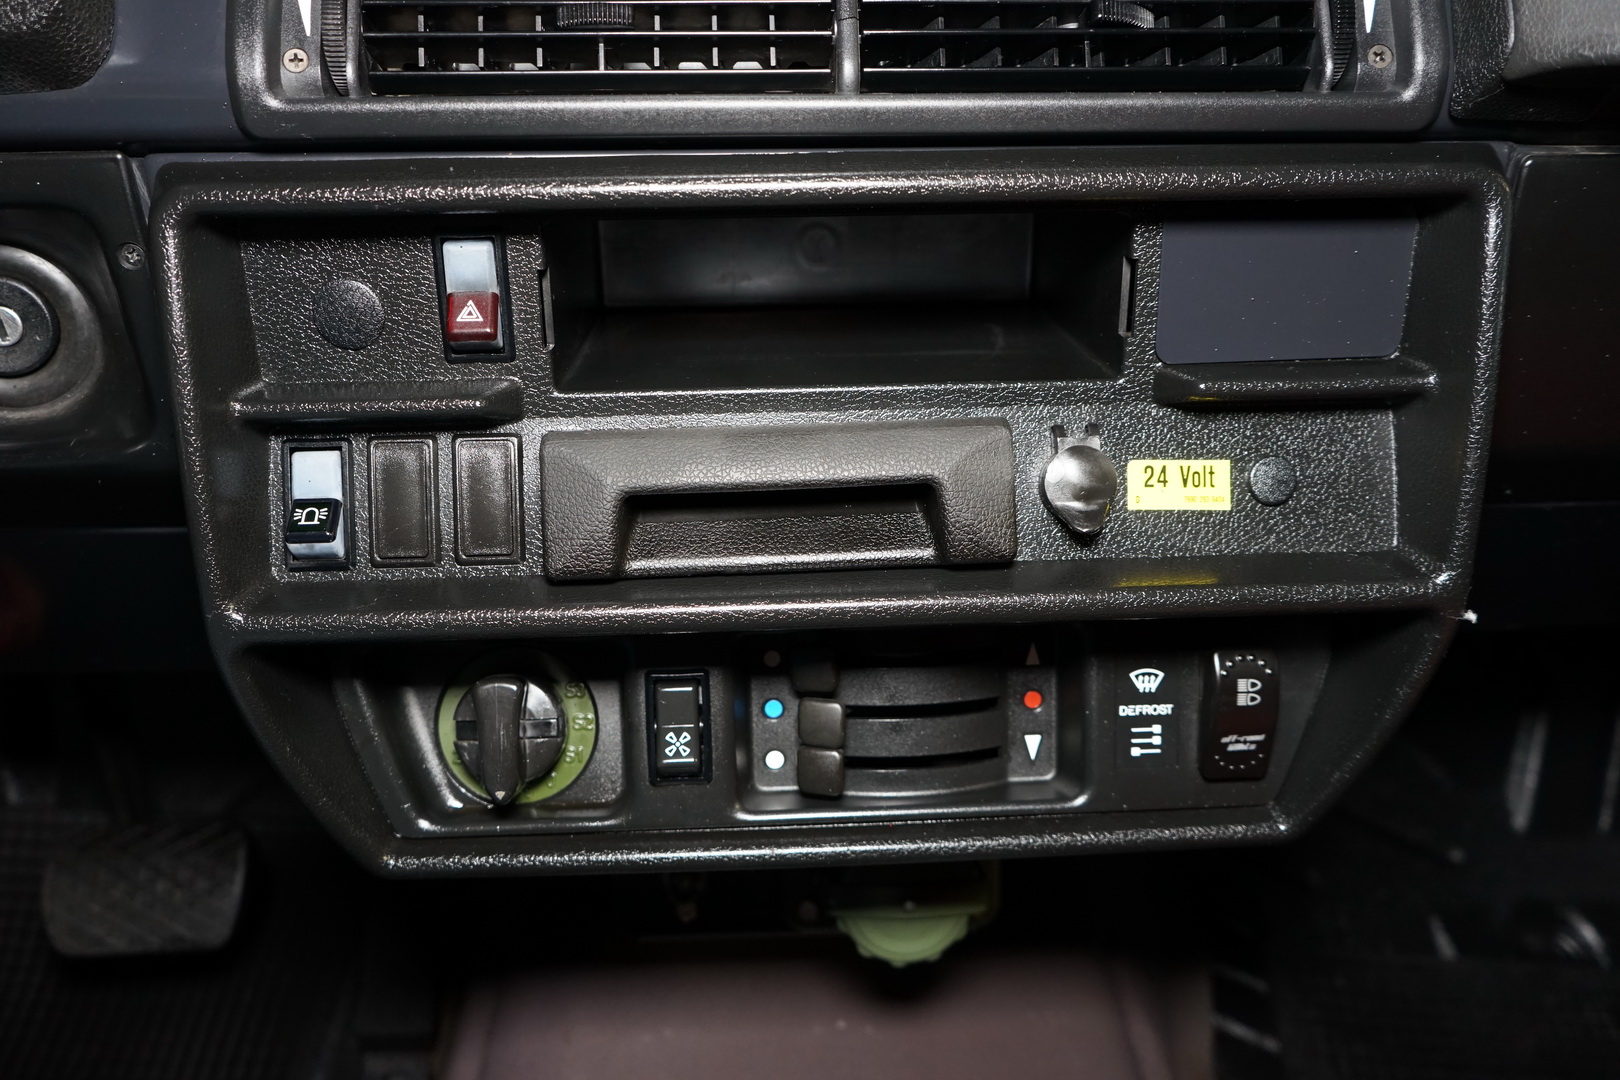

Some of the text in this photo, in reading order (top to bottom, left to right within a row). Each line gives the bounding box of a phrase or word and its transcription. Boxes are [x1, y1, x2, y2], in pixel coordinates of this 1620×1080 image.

[1144, 465, 1215, 488] 24 Volt
[1118, 703, 1174, 717] DEFROST
[573, 712, 595, 730] S2
[564, 745, 584, 763] S1
